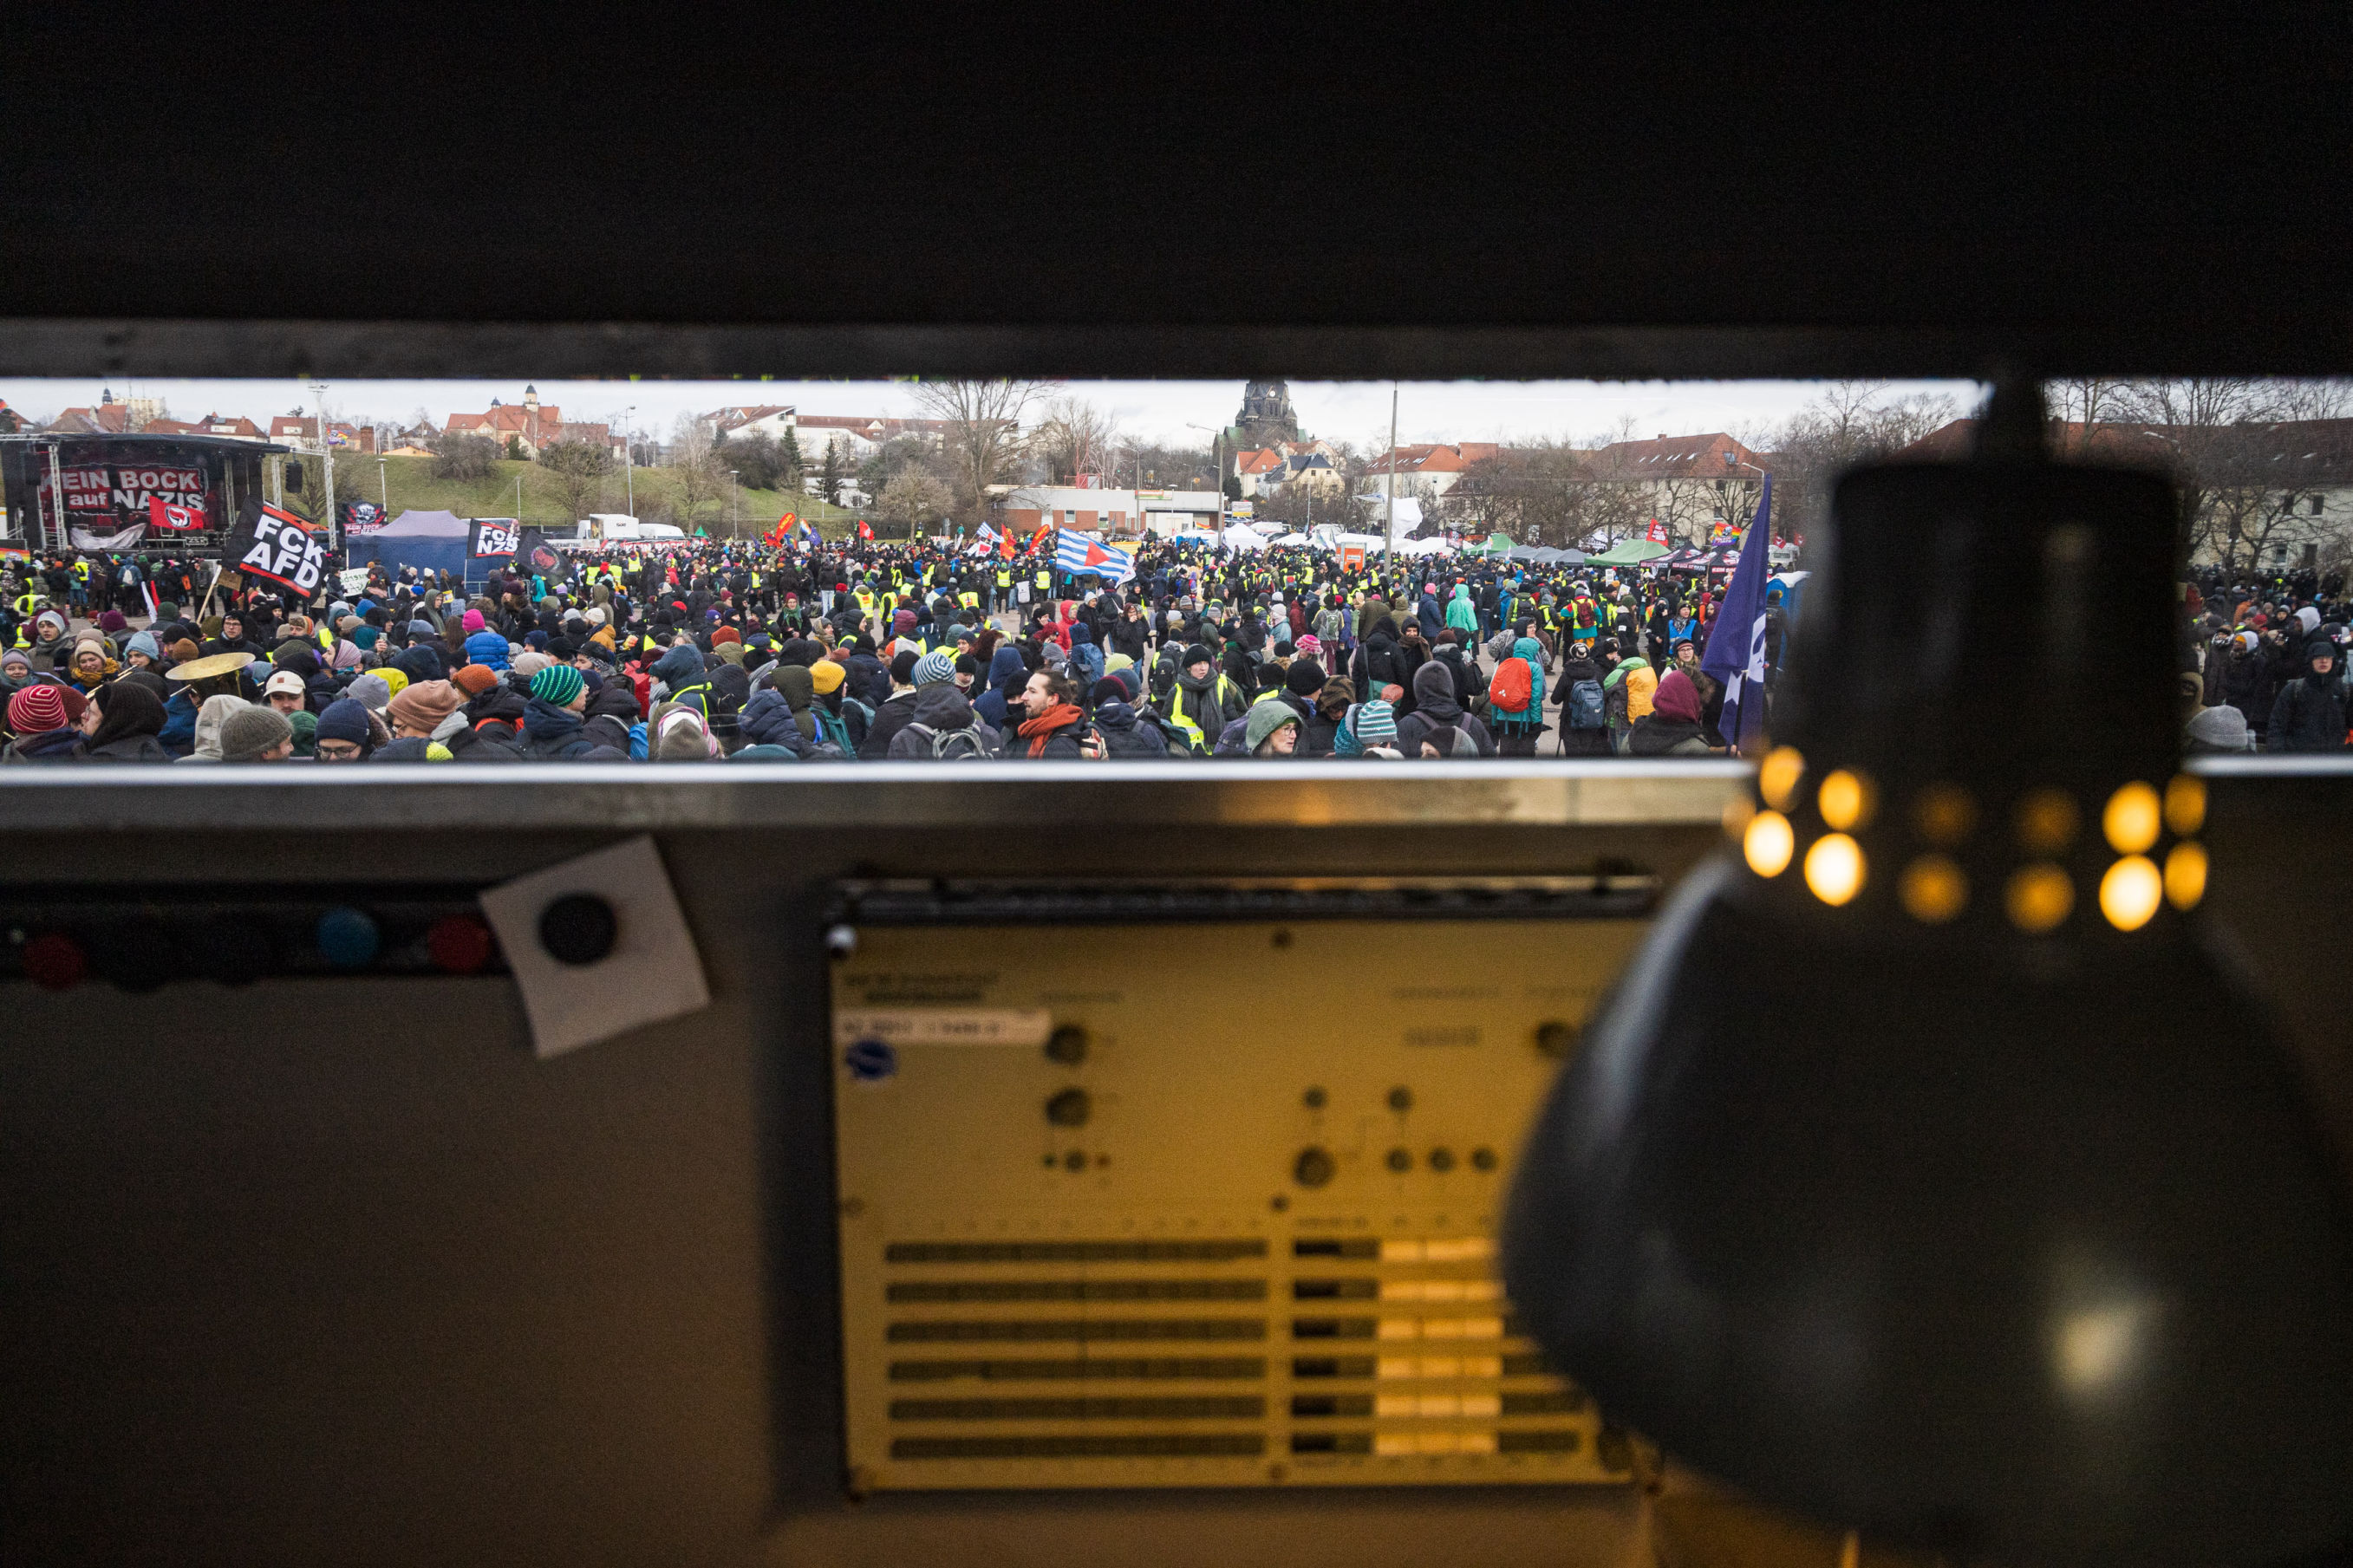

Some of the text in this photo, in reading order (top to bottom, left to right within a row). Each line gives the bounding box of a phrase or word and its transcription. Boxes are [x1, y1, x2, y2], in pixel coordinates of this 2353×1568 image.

[119, 471, 199, 491] BOCK
[69, 492, 108, 506] auf
[254, 514, 323, 569] FCK
[477, 539, 518, 554] NZS
[242, 541, 319, 589] AFD
